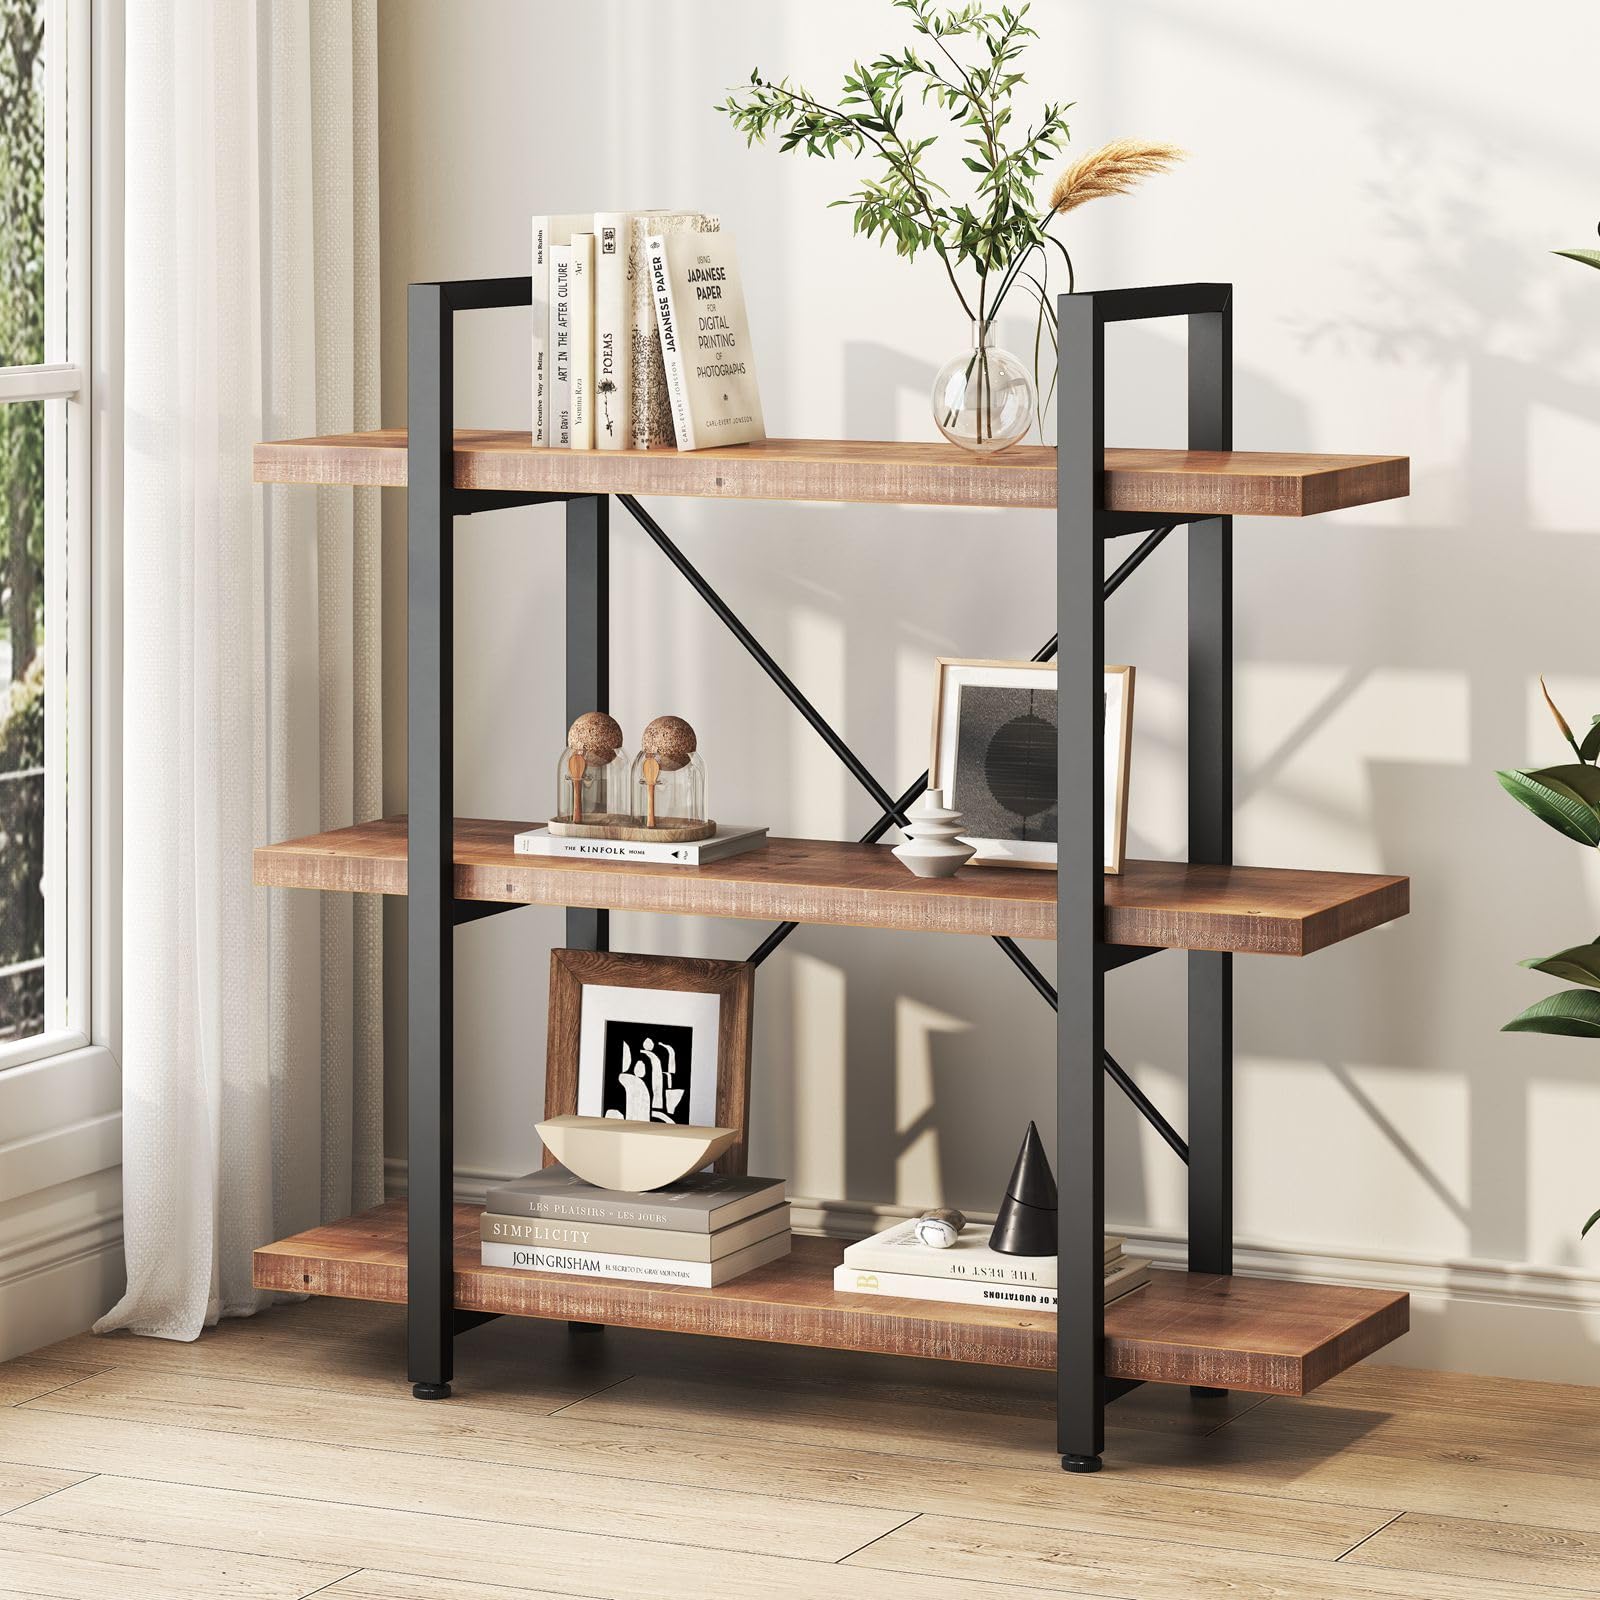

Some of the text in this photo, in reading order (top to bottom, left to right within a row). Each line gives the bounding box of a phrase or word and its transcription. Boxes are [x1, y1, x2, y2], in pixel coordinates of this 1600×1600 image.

[697, 256, 710, 264] USING
[688, 267, 725, 283] JAPANESE
[697, 287, 721, 299] PAPER
[653, 256, 676, 353] JAPANESE PAPER
[558, 263, 568, 381] ART IN THE AFTER CULTURE
[699, 317, 729, 330] DIGITAL
[699, 333, 735, 348] PRINTING
[603, 334, 613, 374] POEMS
[716, 352, 722, 360] OF
[697, 363, 745, 377] PHOTOGRAPHS
[672, 361, 688, 443] CARL-EVERT JONSSON
[575, 397, 583, 425] Yasmina
[706, 417, 752, 428] CARL-EVERT JONSSON
[580, 846, 625, 855] KINFOLK
[530, 1202, 667, 1223] LES PLAISIRS LES JOURS
[493, 1224, 591, 1243] SIMPLICITY
[950, 1265, 1037, 1281] THE BEST OF
[984, 1291, 1036, 1303] QUOTATIONS
